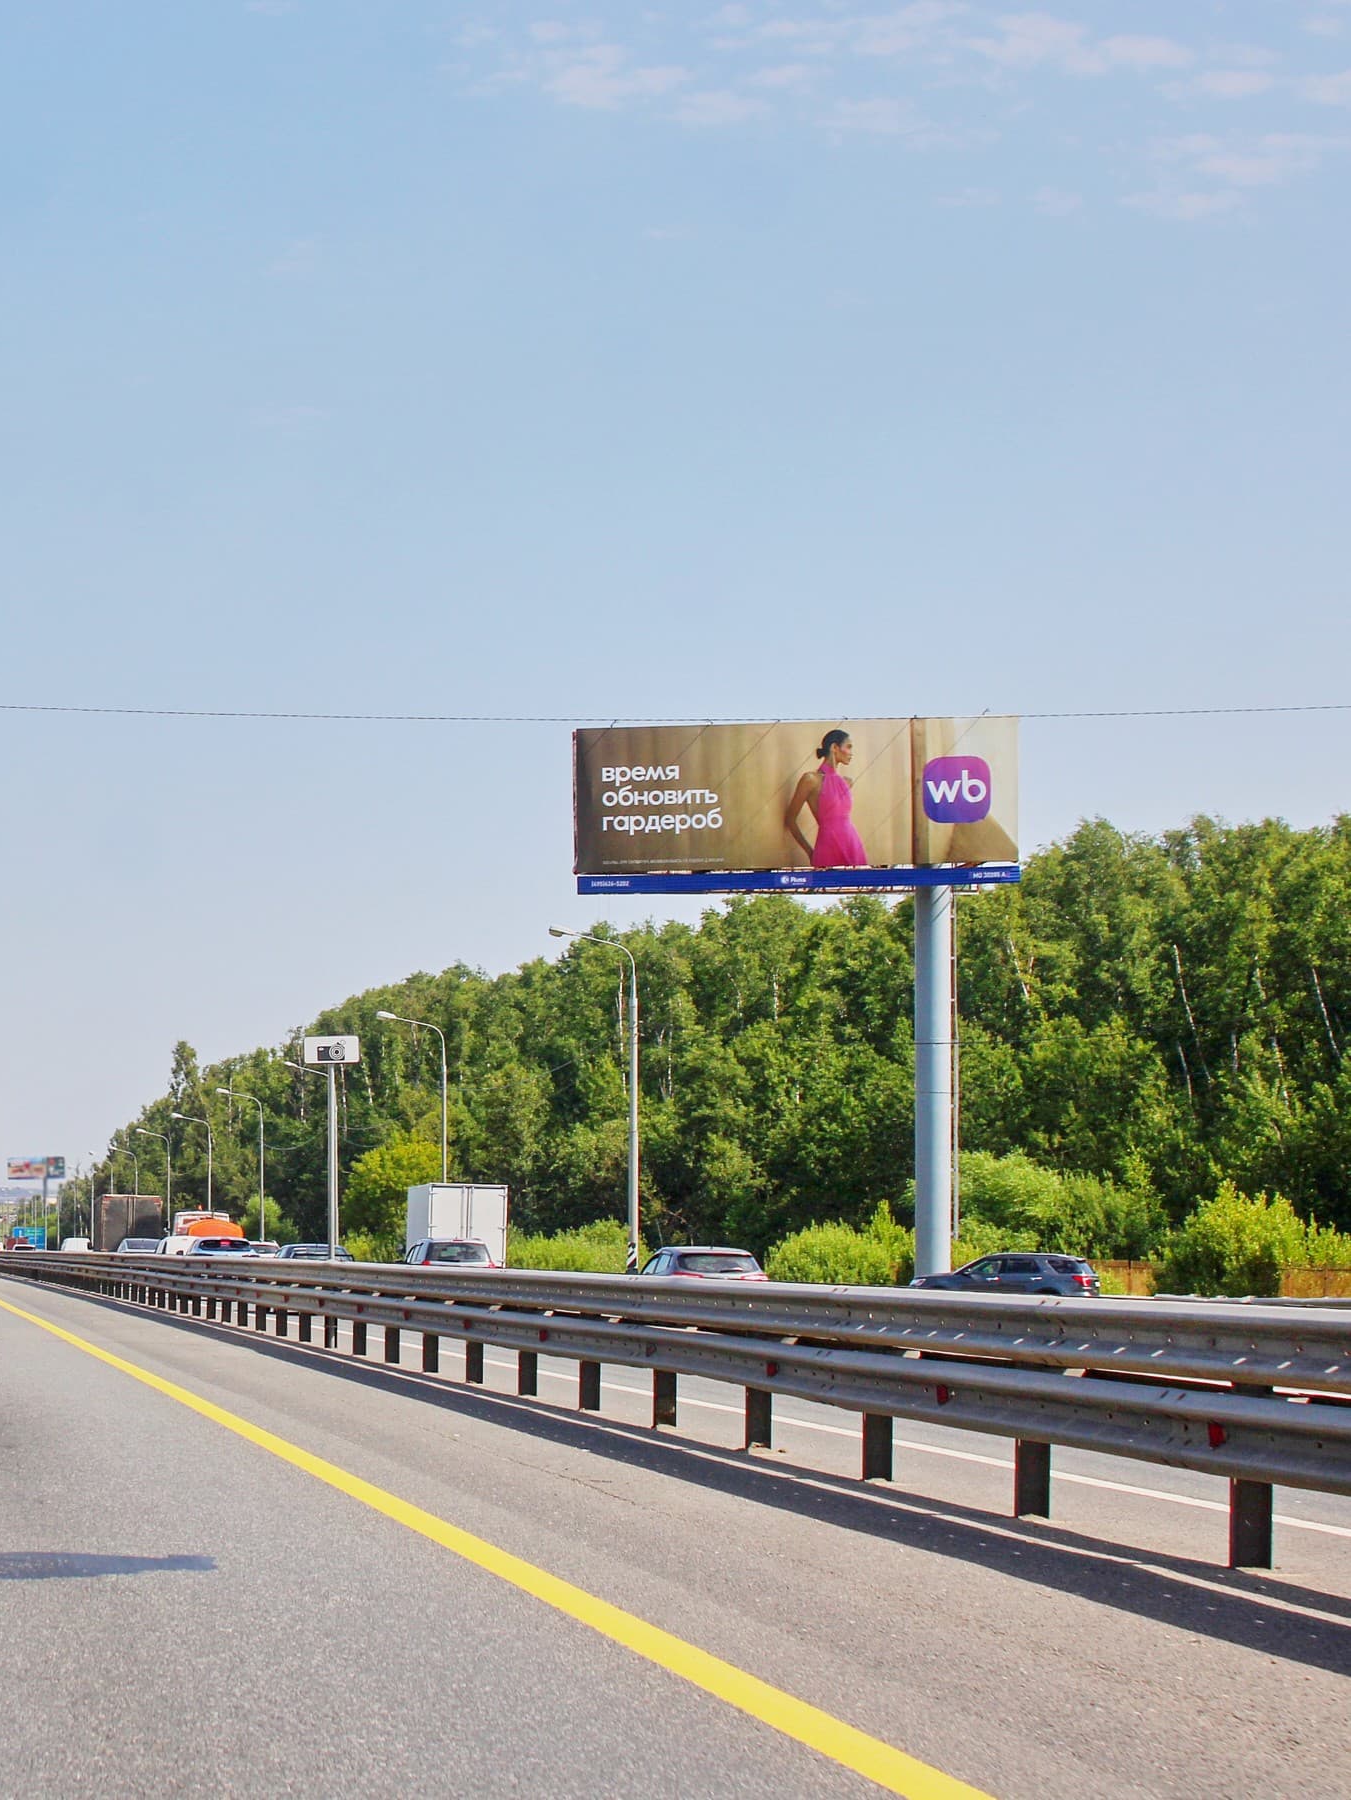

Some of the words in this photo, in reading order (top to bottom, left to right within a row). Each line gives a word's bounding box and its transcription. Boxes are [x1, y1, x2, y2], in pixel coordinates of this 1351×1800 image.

[601, 765, 680, 787] время
[926, 769, 987, 804] wb
[601, 784, 719, 807] обновить
[602, 807, 723, 836] гардероб
